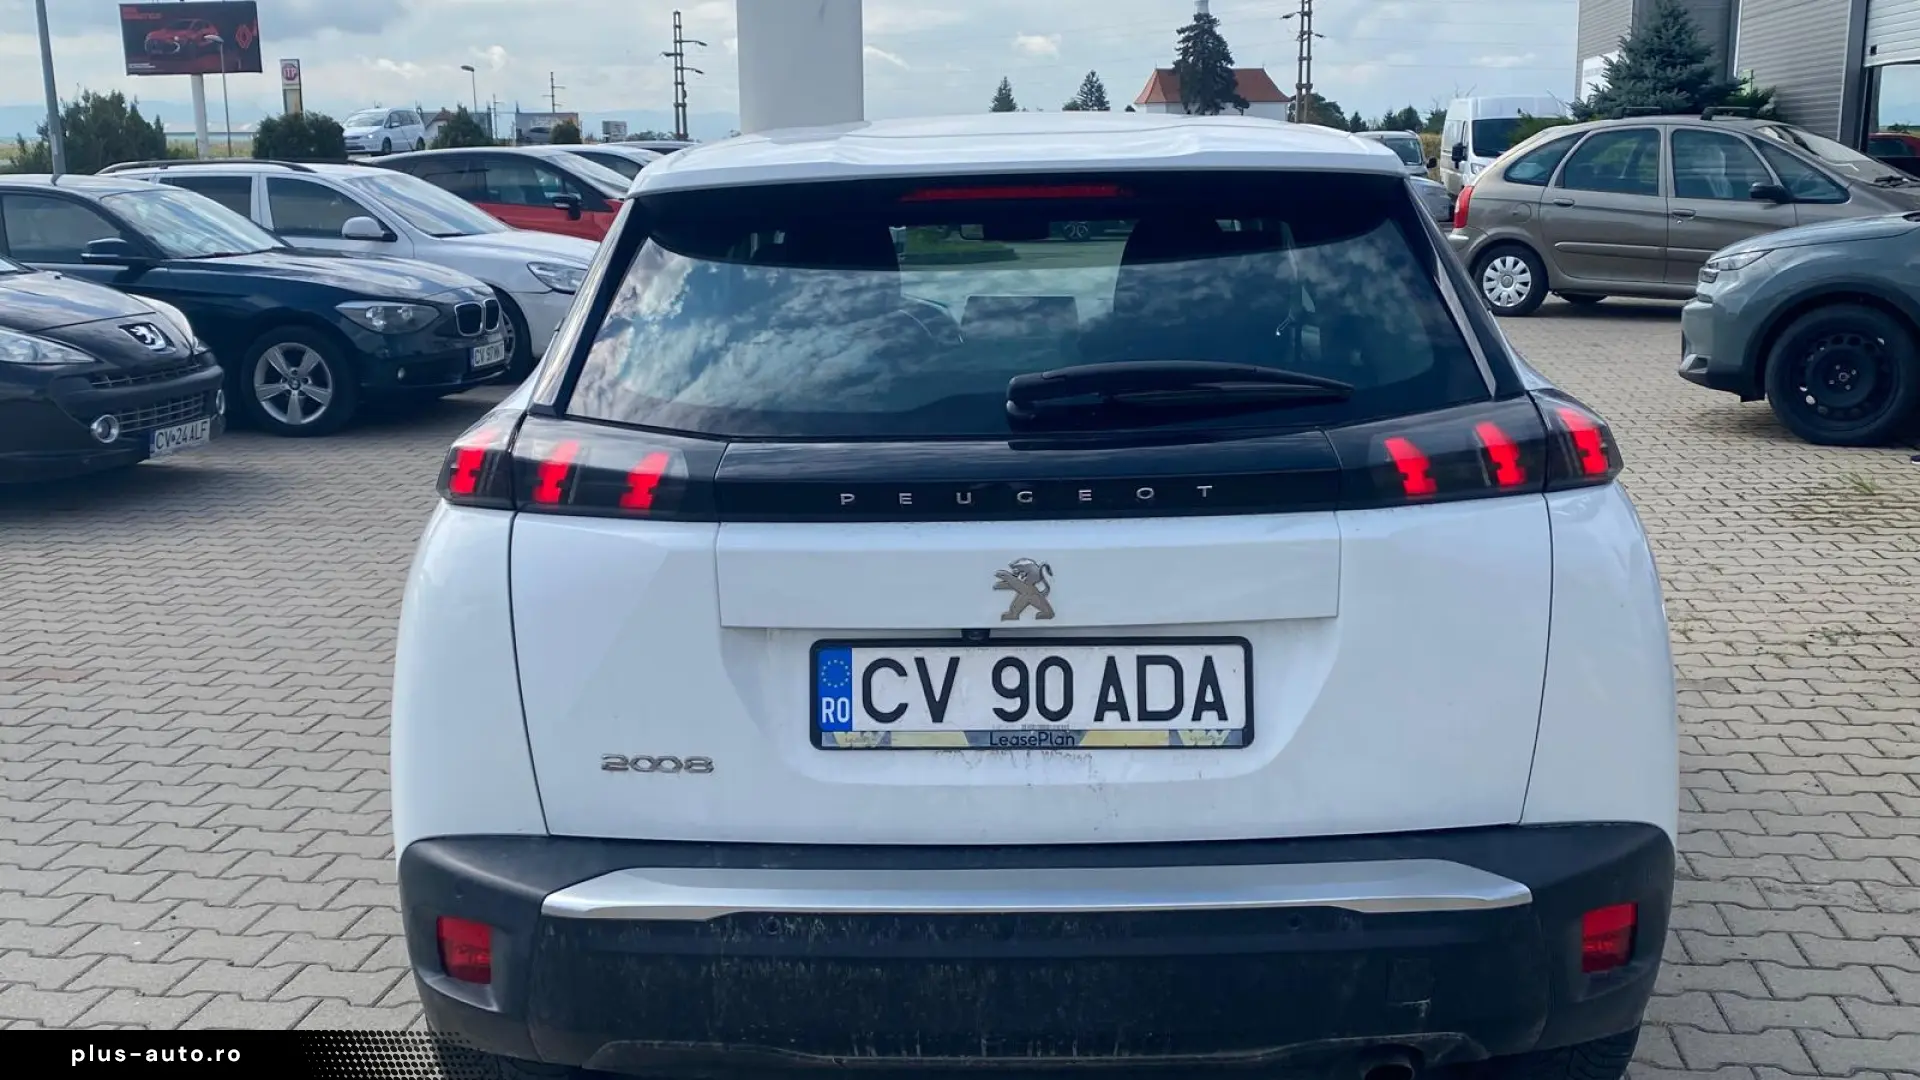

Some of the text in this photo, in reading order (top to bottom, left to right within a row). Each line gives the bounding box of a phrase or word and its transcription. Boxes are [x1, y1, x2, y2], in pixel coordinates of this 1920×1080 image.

[156, 421, 208, 450] CV 24 ALF
[840, 484, 1213, 505] PEUGEOT
[861, 655, 1229, 723] CV 90 ADA
[822, 697, 850, 723] RO
[989, 731, 1075, 746] LeasePlan
[601, 753, 715, 774] 2008
